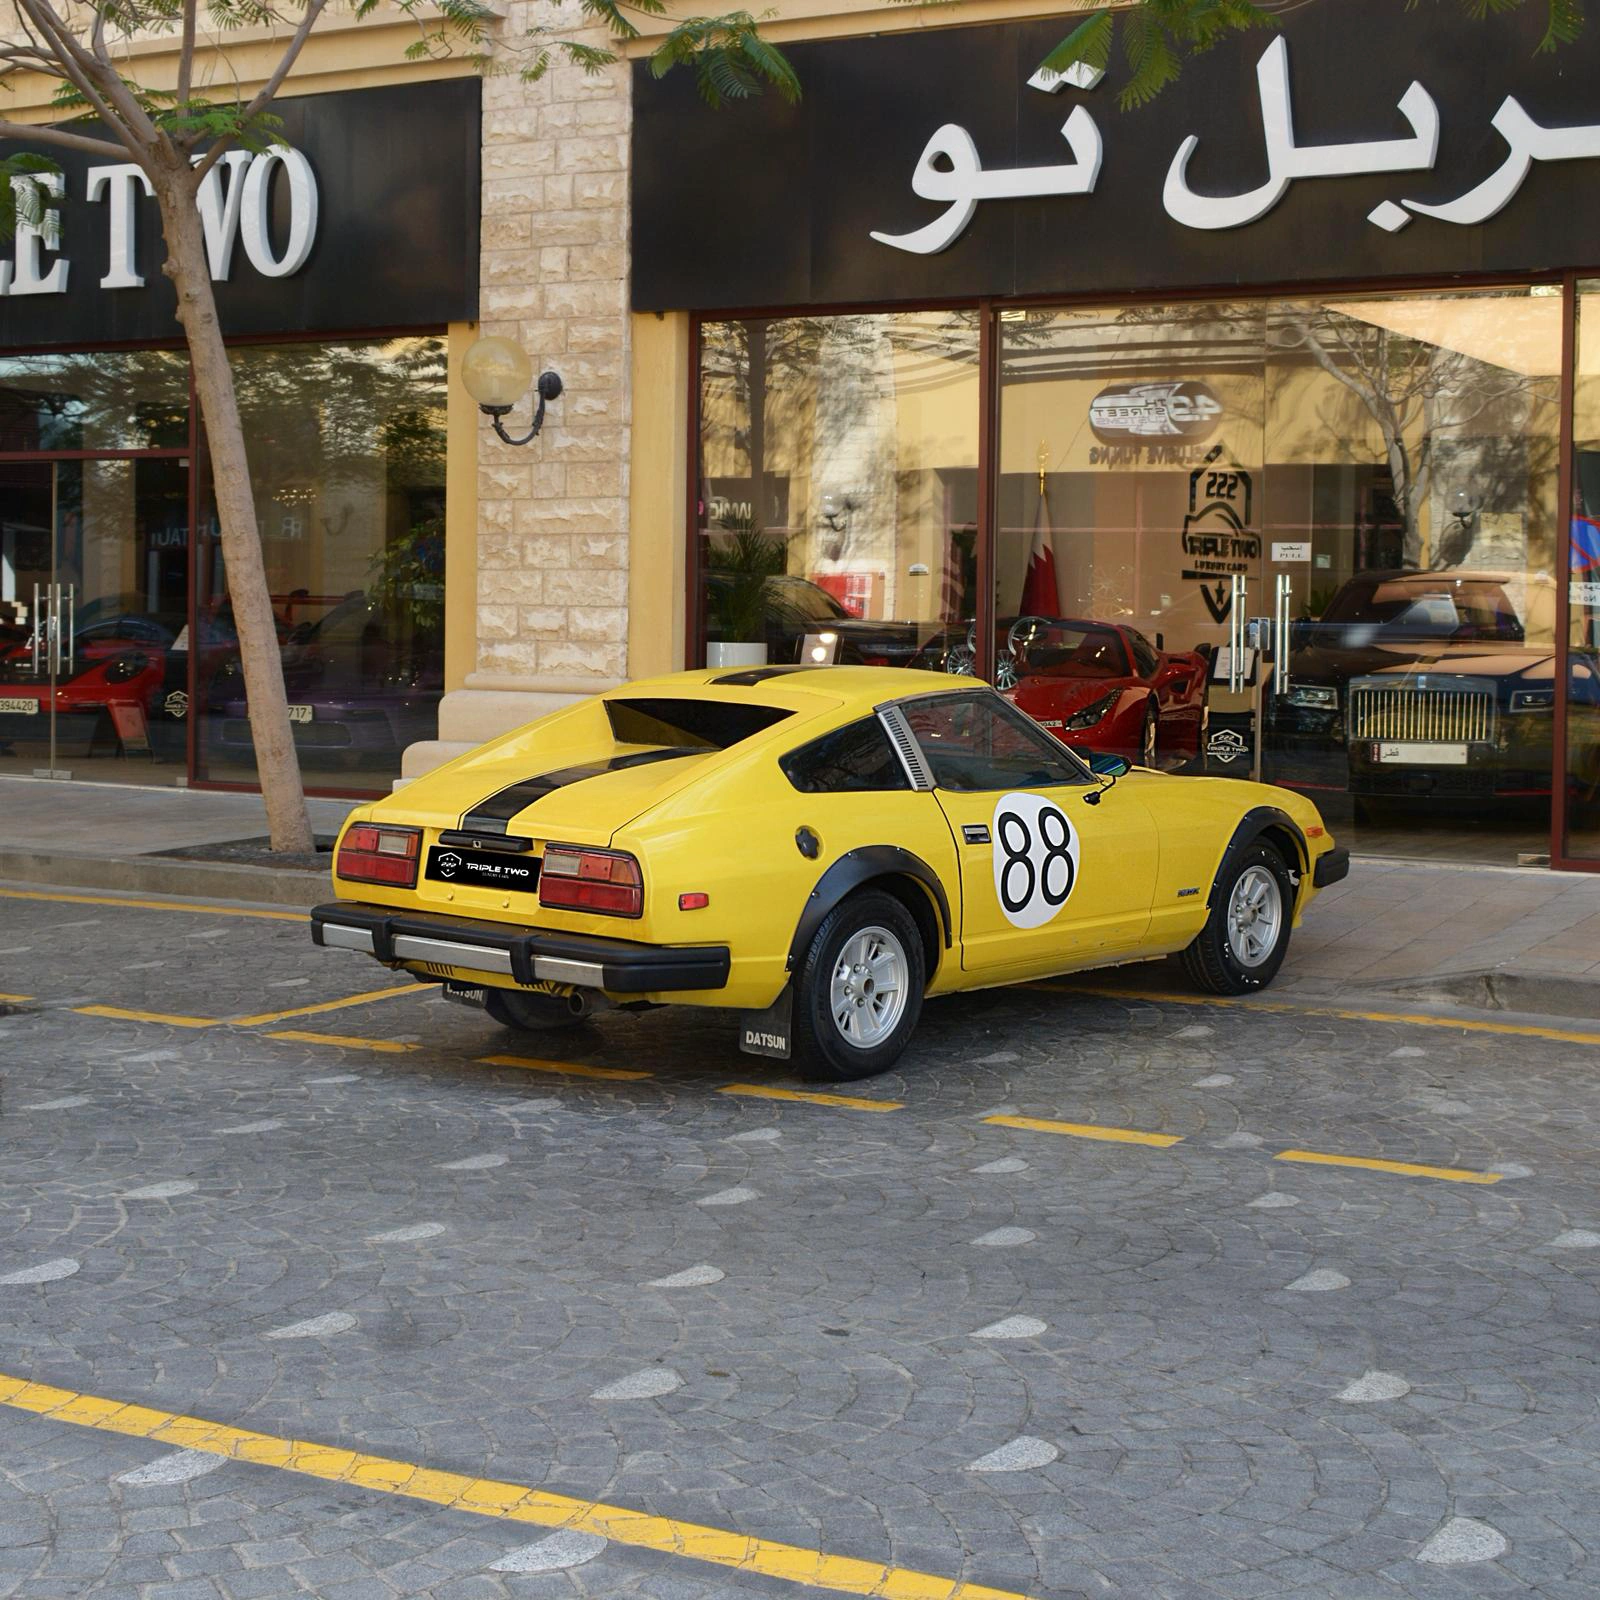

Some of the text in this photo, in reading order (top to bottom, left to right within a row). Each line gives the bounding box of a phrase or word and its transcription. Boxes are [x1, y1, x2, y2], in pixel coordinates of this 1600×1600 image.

[869, 34, 1600, 255] ربل تو
[0, 144, 318, 296] E TWO
[1206, 472, 1238, 499] 222
[1188, 535, 1258, 559] TRIPLE TWO
[1194, 559, 1248, 572] LUXURY CARS
[466, 862, 530, 876] TRIPLE TWO
[998, 806, 1075, 913] 88
[745, 1030, 786, 1050] DATSUN
